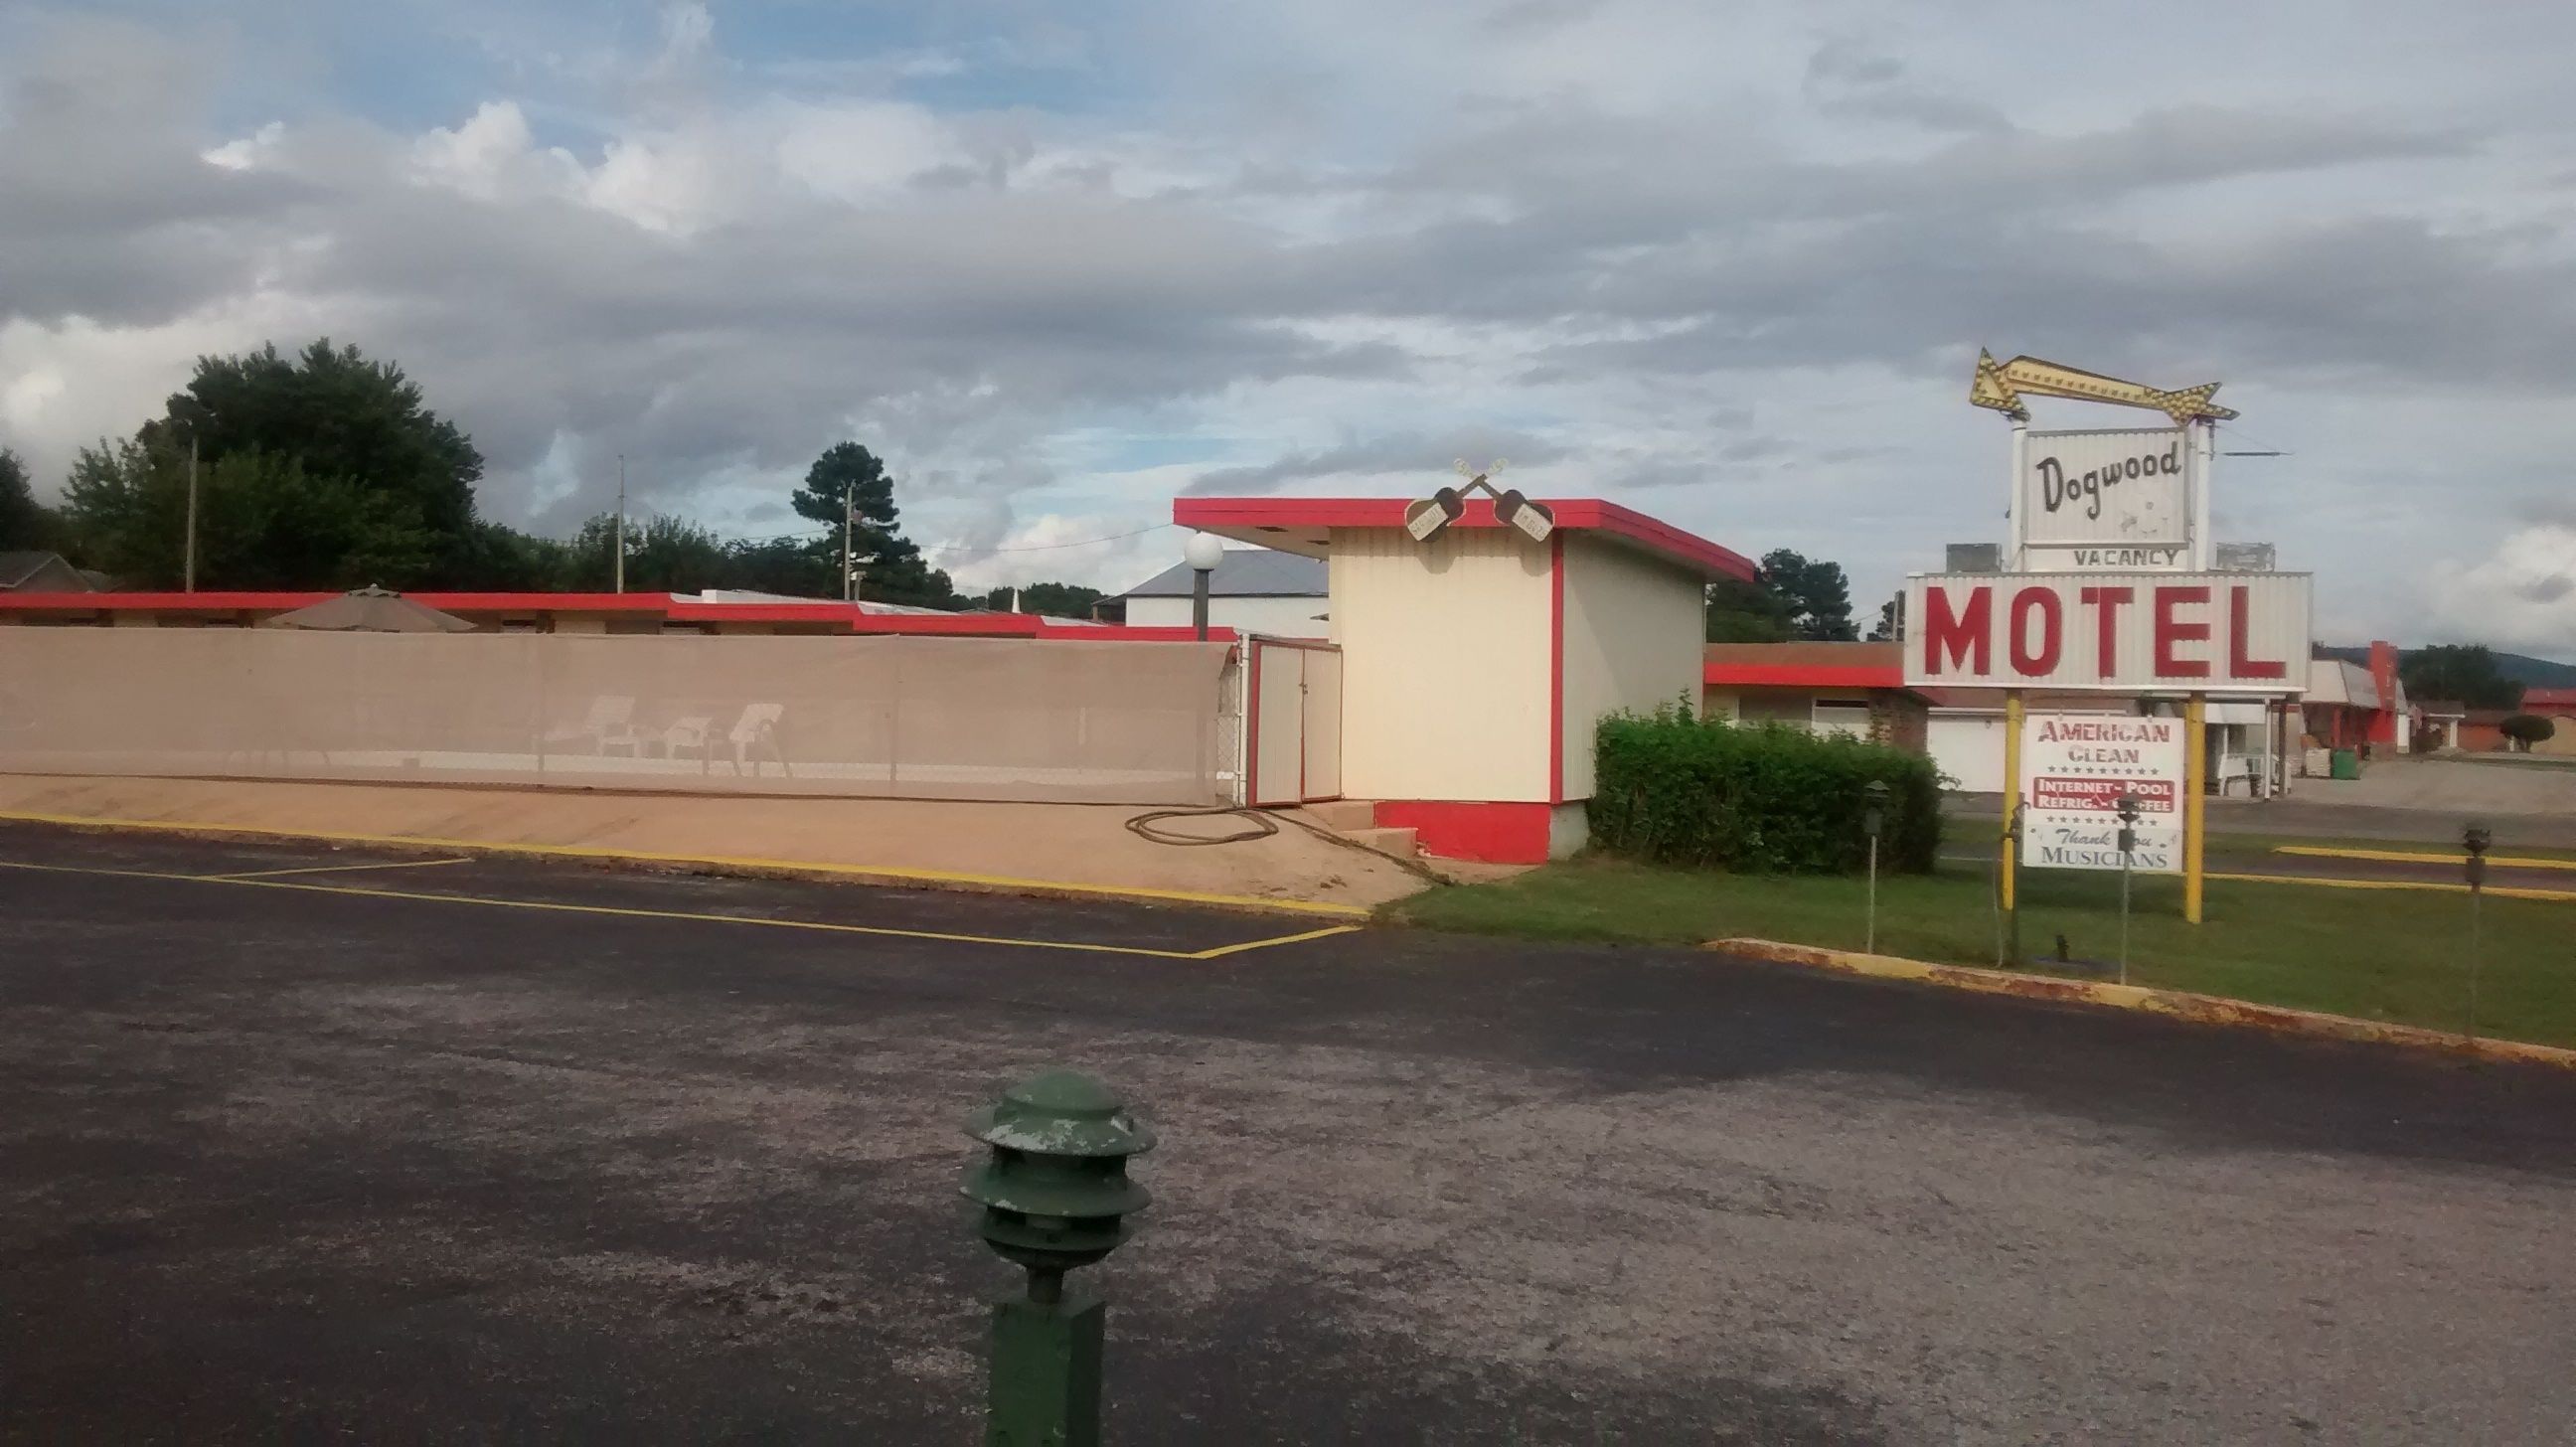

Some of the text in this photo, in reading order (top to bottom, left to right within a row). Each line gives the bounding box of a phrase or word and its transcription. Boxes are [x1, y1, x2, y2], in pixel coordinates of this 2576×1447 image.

[2035, 440, 2182, 521] Dogwood
[2073, 549, 2180, 567] VACANCY
[1925, 585, 2287, 679] MOTEL
[2037, 721, 2171, 742] AMERICAN
[2067, 745, 2140, 763] CLEAN
[2126, 781, 2172, 795] POOL
[2055, 828, 2111, 846] Thank
[2041, 846, 2168, 868] MUSICIANS
